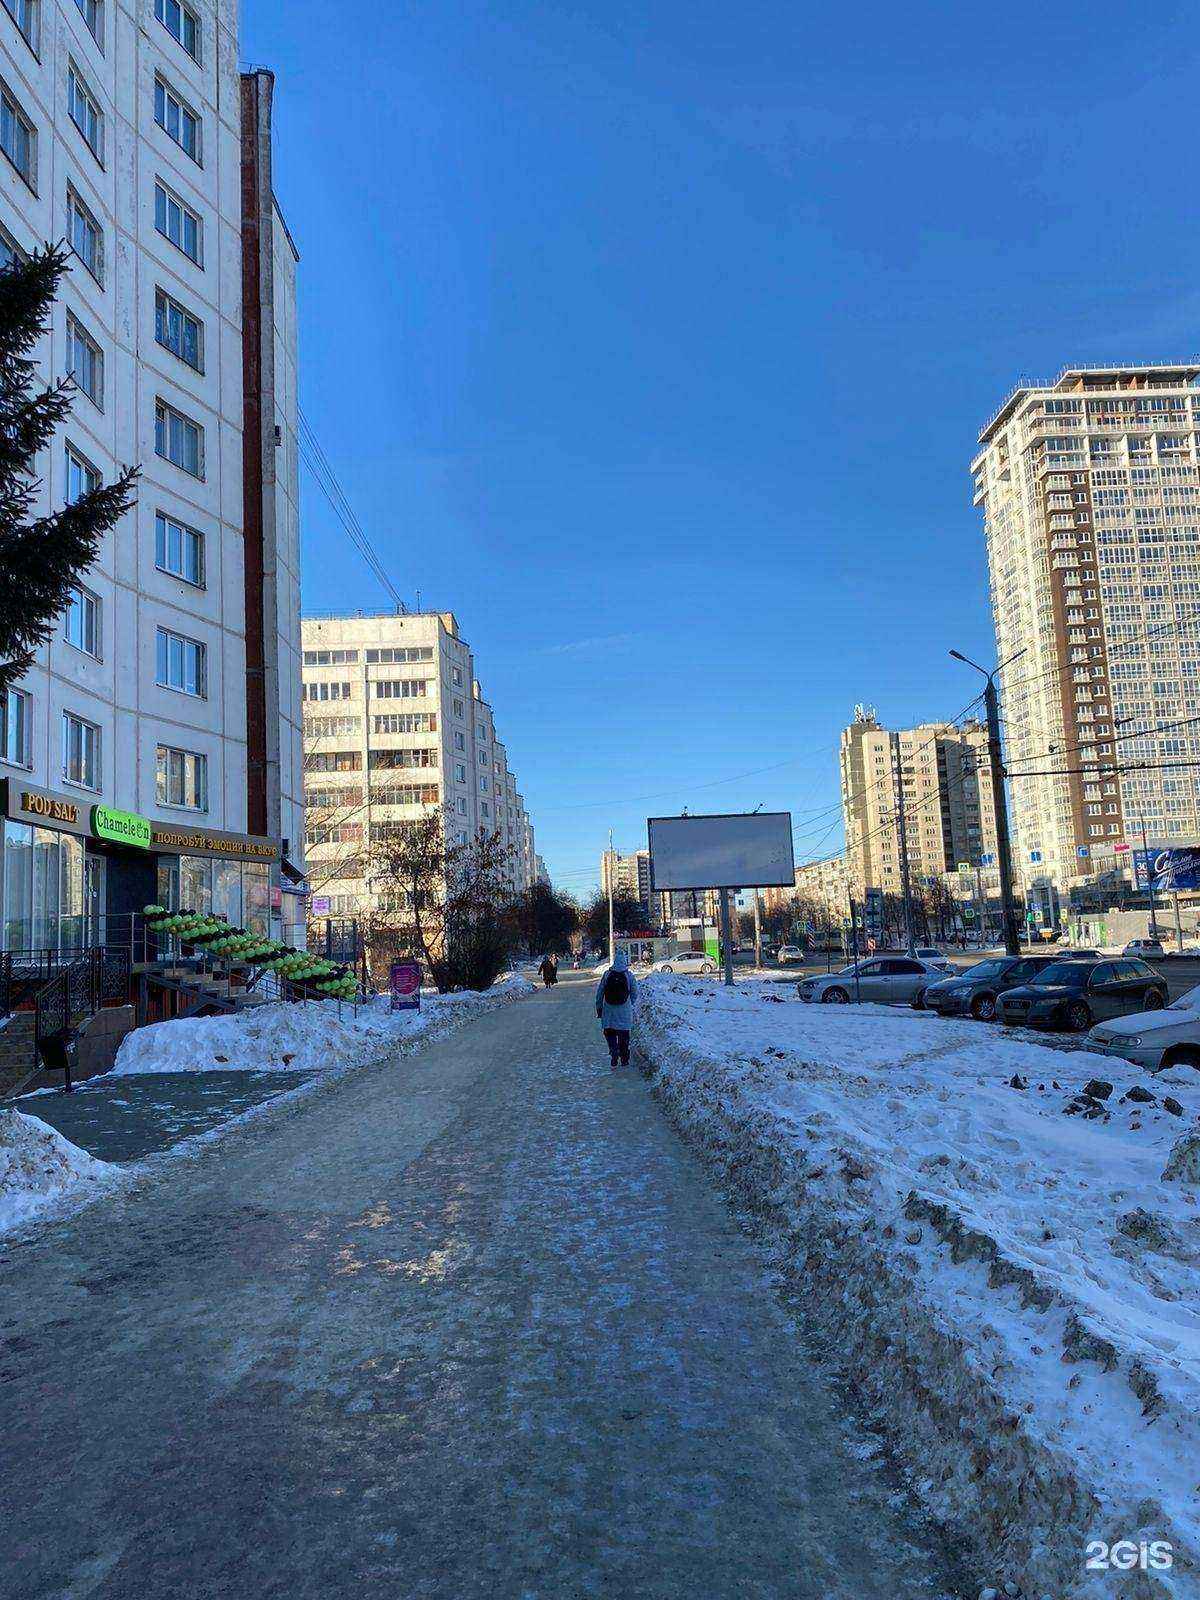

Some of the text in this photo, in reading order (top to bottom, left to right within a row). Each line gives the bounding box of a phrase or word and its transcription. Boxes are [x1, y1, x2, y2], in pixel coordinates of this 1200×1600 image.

[26, 793, 52, 816] POD
[97, 810, 150, 840] Chameleon
[157, 832, 207, 849] ПОПРОБУЙ
